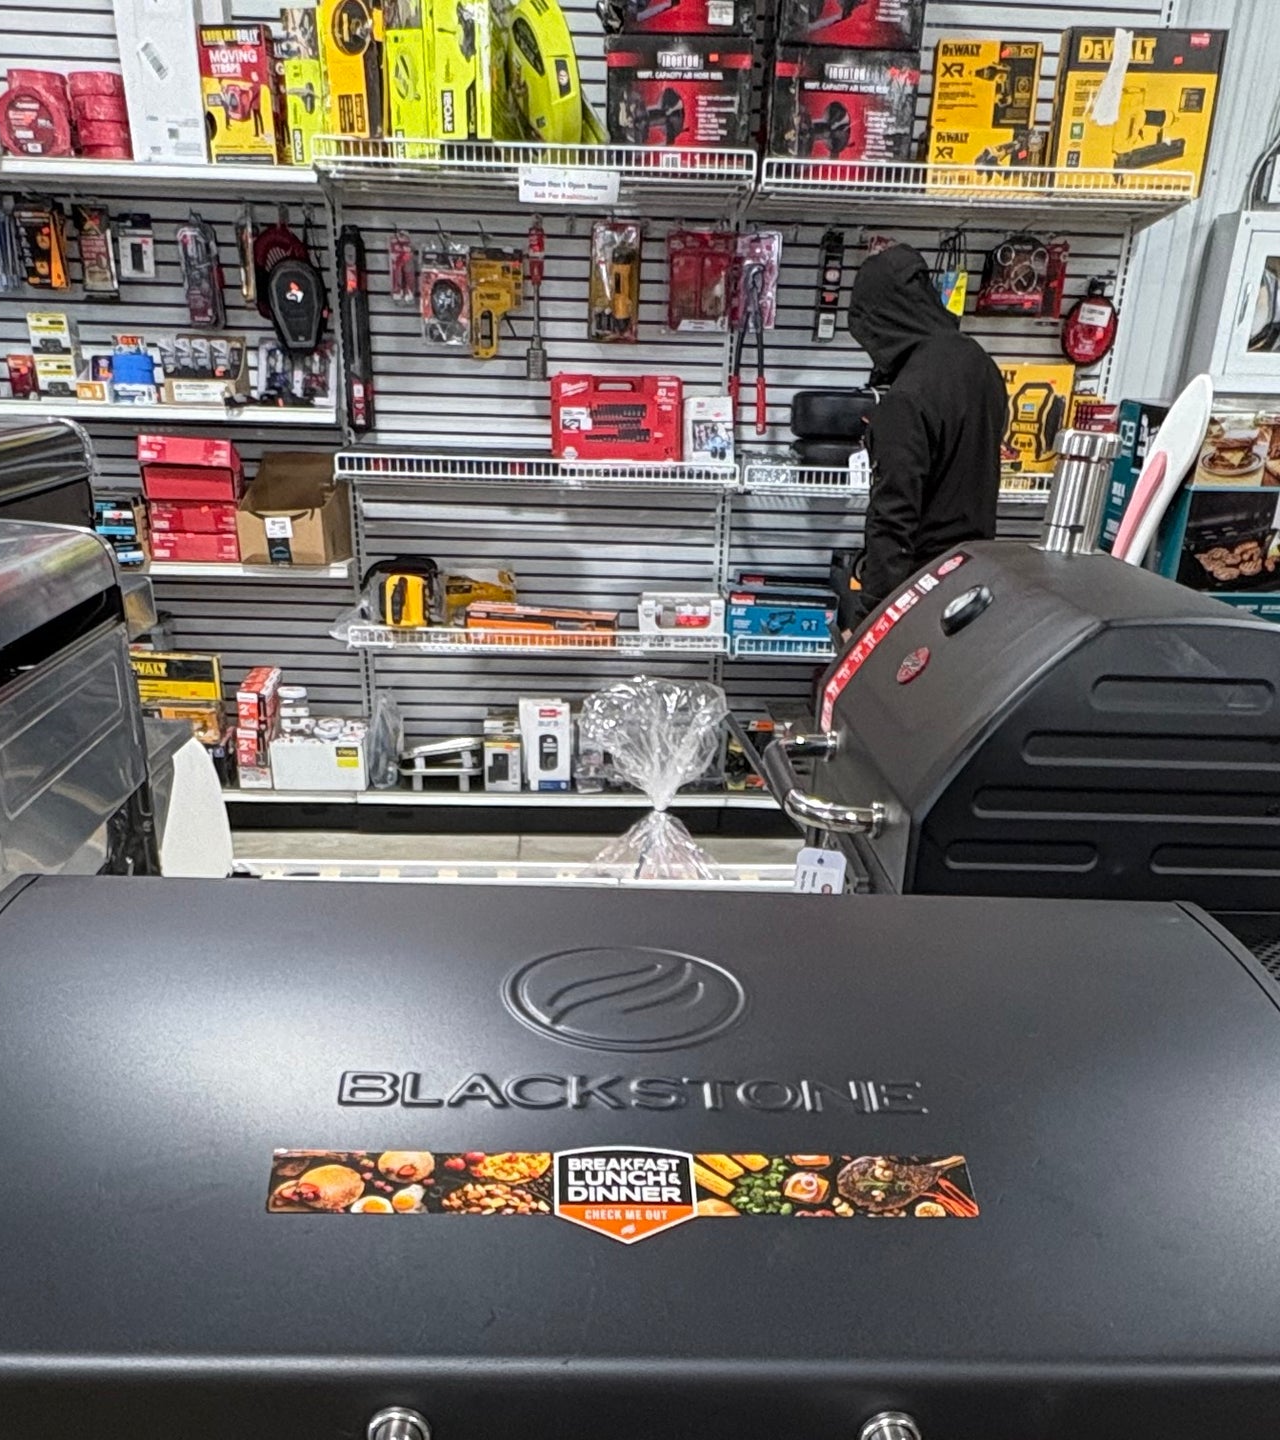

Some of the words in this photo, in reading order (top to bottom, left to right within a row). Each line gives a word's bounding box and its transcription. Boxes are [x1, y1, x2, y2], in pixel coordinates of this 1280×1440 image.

[209, 50, 258, 63] MOVING
[941, 44, 981, 57] DEWALT
[940, 63, 964, 78] XR
[936, 132, 969, 144] DEWALT
[935, 148, 953, 159] XR
[129, 662, 168, 677] WALT
[335, 1070, 929, 1113] BLACKSTONE
[568, 1157, 680, 1171] BREAKFAST
[568, 1171, 667, 1186] LUNCH
[568, 1186, 682, 1202] DINNER
[584, 1209, 622, 1221] CHECK
[625, 1209, 643, 1221] ME
[645, 1209, 668, 1221] OUT
